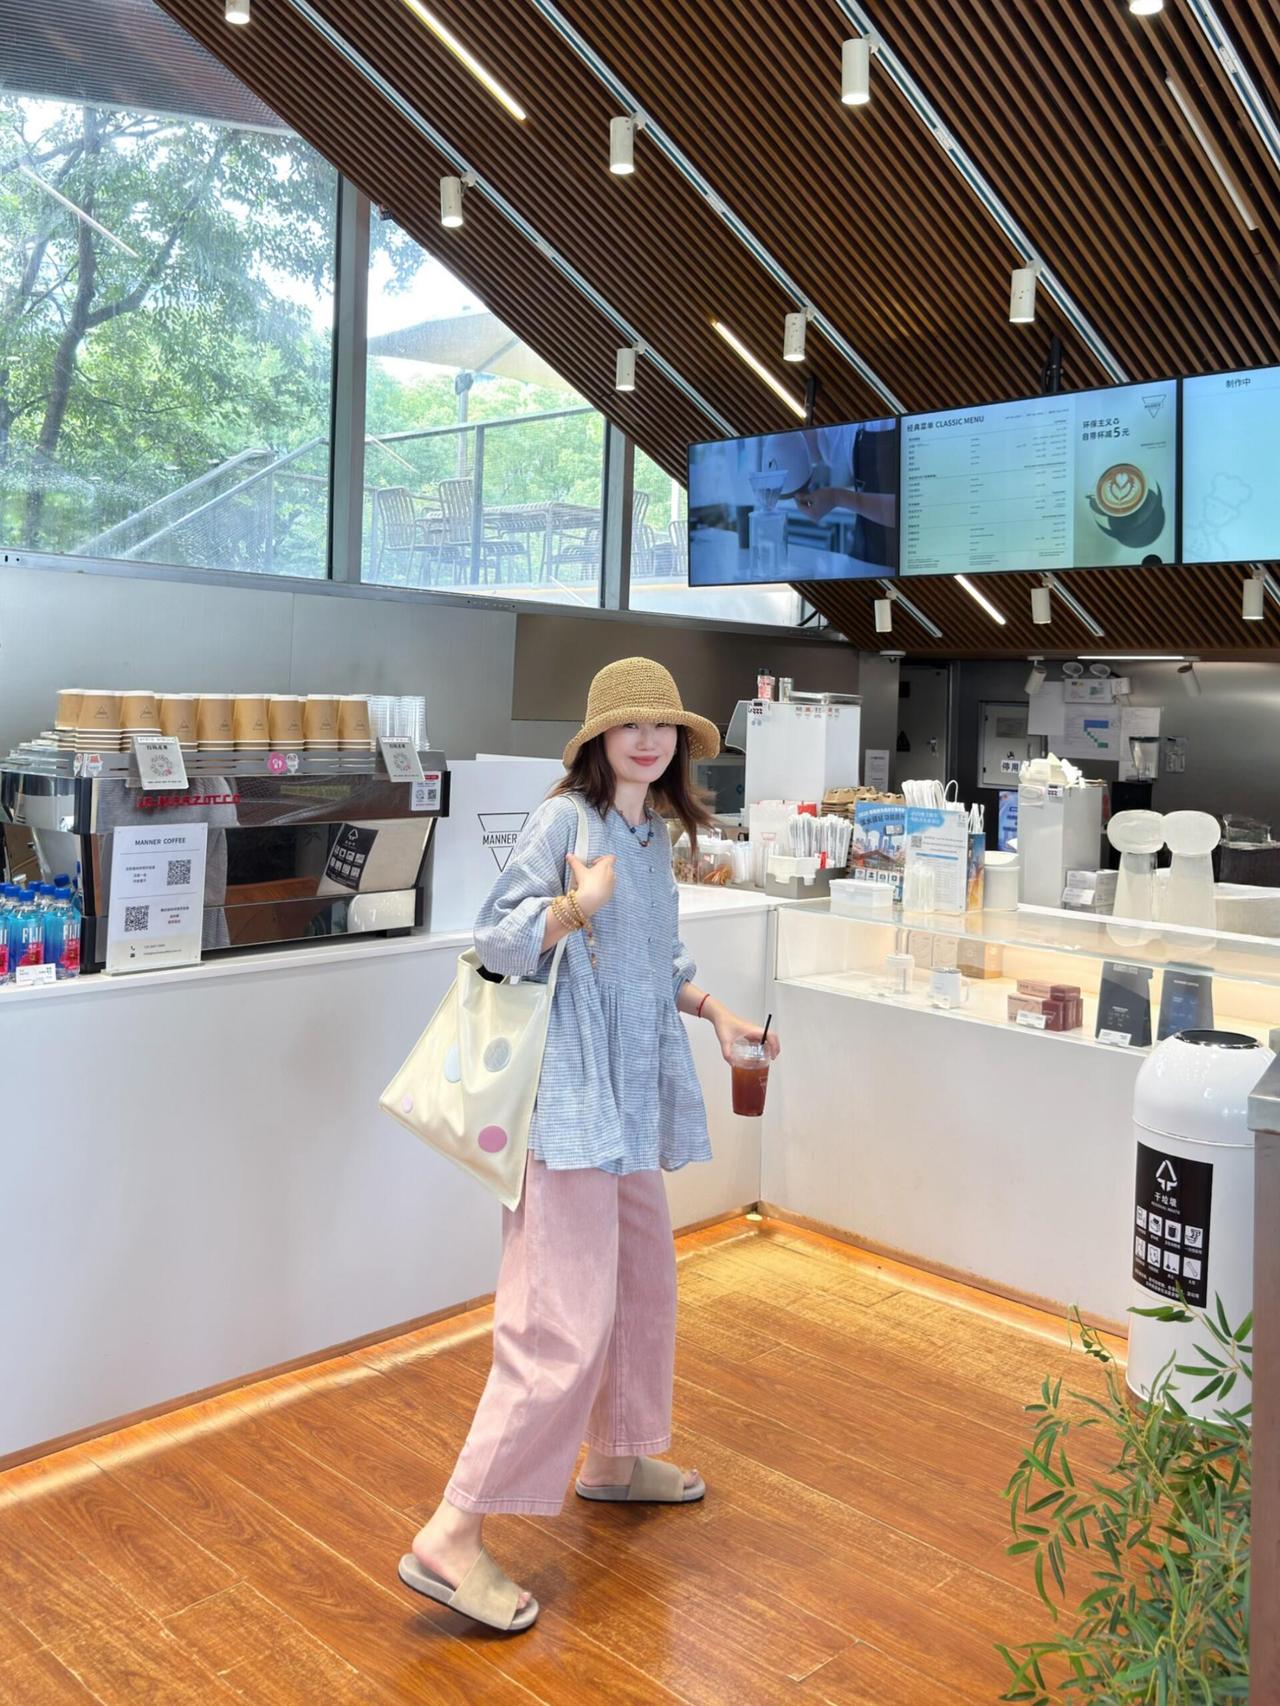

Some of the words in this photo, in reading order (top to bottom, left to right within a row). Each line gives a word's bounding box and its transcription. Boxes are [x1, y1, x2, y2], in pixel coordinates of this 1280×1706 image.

[1225, 378, 1252, 388] 制作中
[935, 417, 963, 429] CLASSIC
[964, 415, 985, 424] MENU
[1082, 418, 1113, 429] 环保主义
[1002, 761, 1019, 772] 停用
[135, 838, 161, 846] MANNER
[482, 833, 518, 845] MANNER
